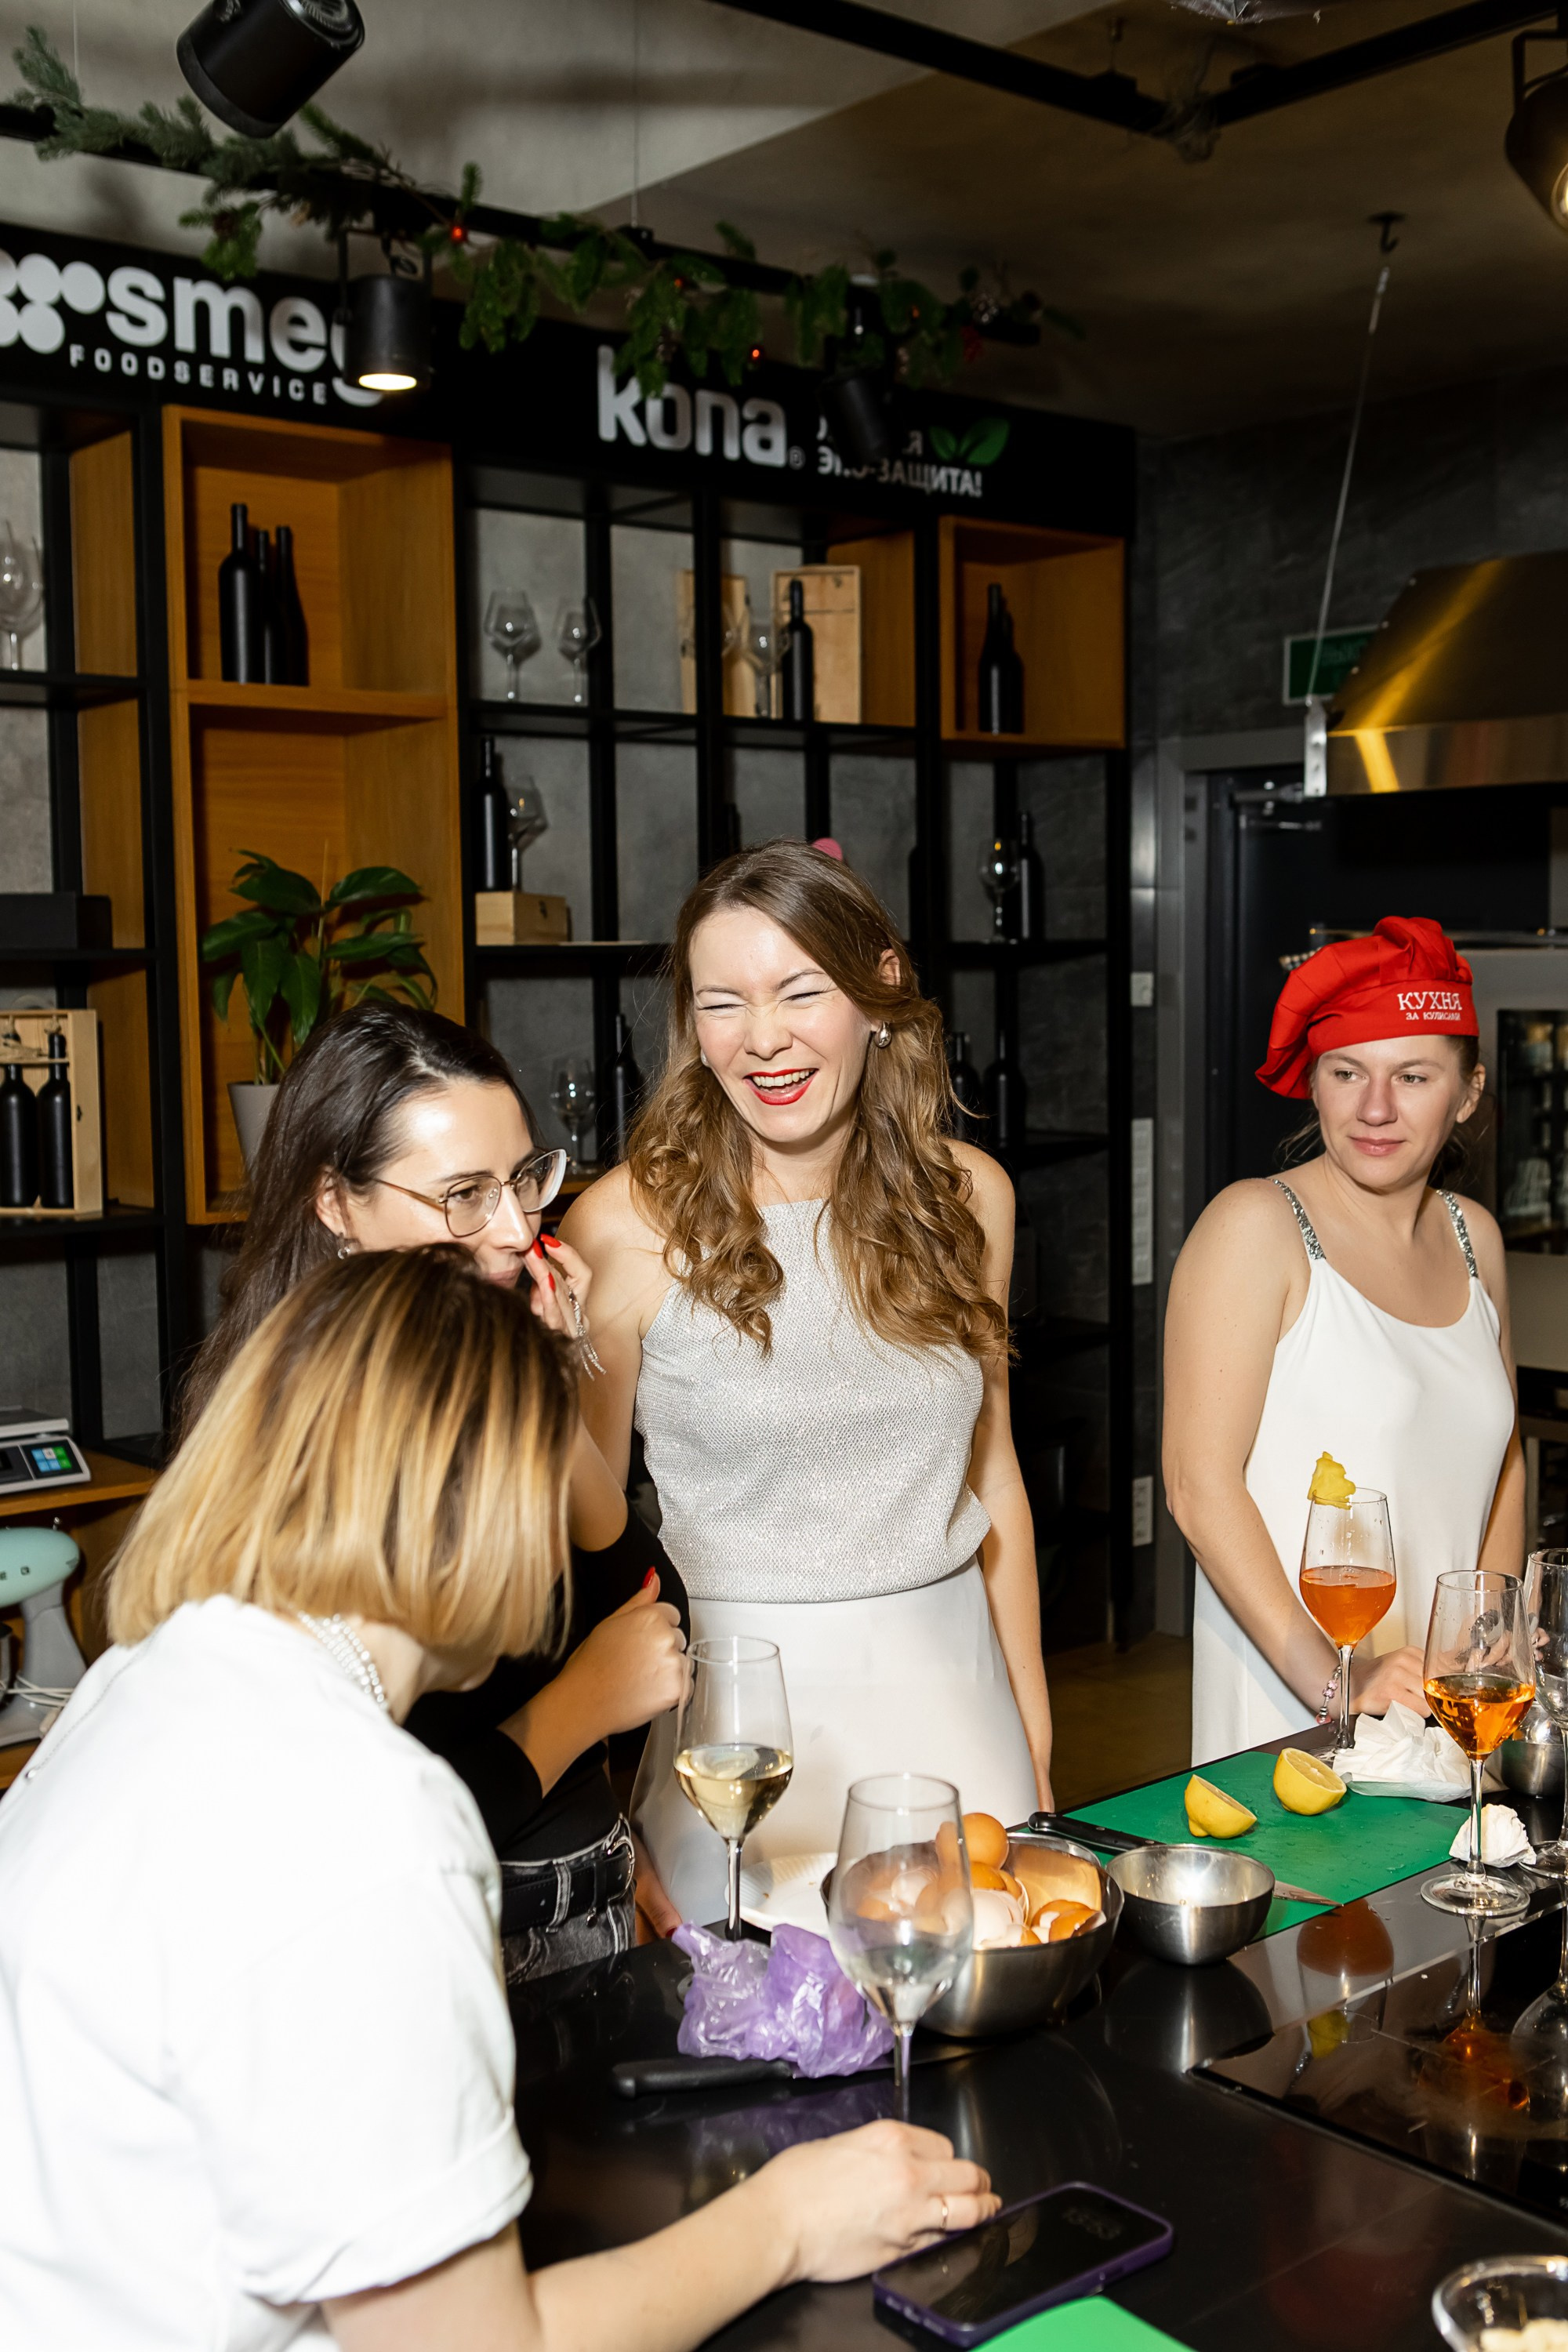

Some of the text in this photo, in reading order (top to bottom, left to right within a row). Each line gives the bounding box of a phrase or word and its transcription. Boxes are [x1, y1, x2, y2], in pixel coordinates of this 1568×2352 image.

[69, 343, 328, 405] FOODSERVICE
[1397, 991, 1463, 1011] КУХНЯ
[1406, 1011, 1461, 1022] ЗА КУЛИСАМИ
